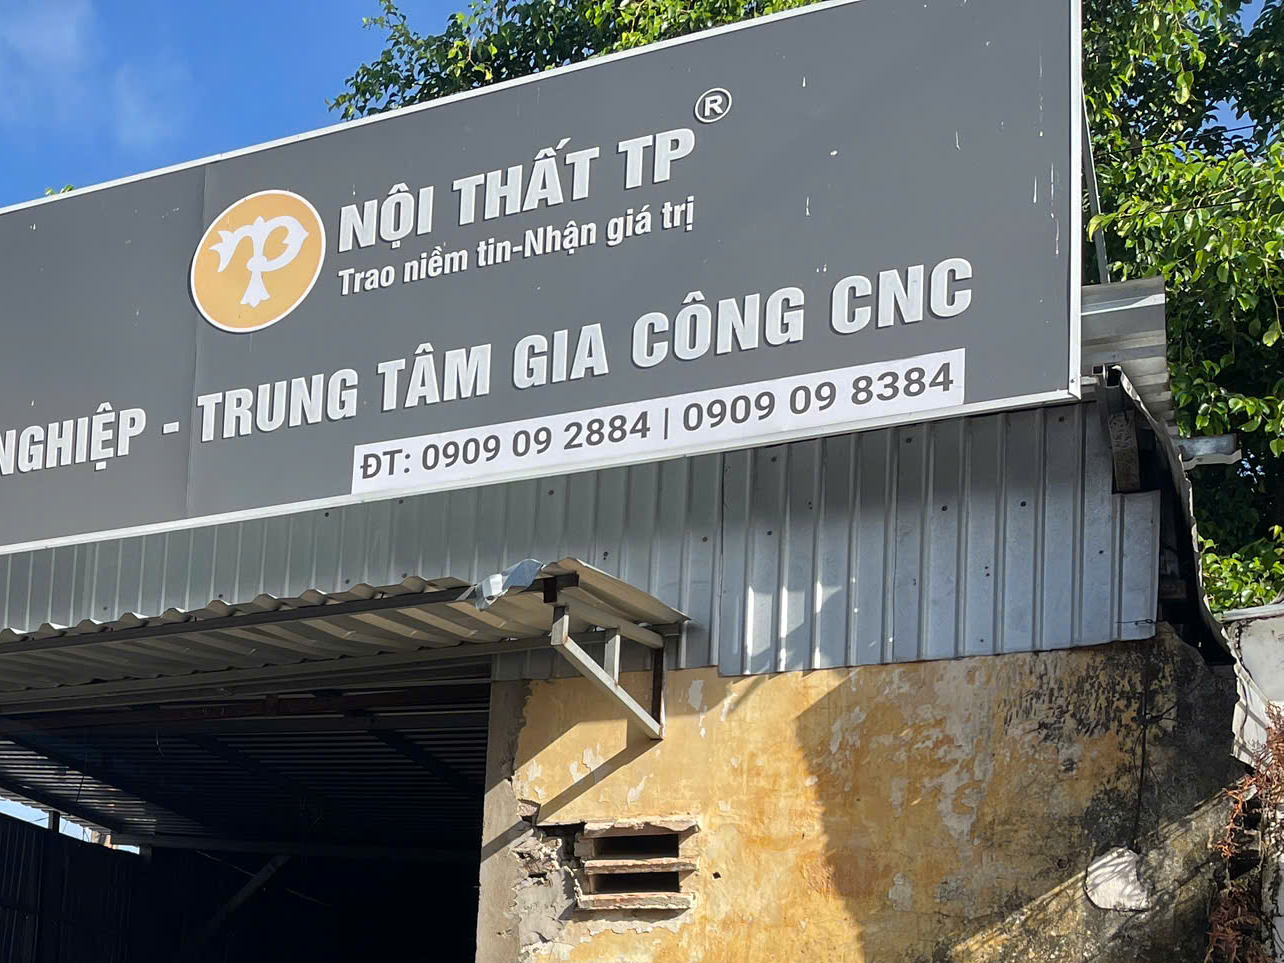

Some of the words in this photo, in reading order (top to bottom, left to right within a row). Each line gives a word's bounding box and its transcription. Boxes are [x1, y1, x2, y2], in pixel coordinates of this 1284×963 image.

[337, 182, 435, 253] NỘI
[452, 137, 601, 227] THẤT
[616, 127, 696, 190] TP
[337, 264, 395, 296] Trao
[403, 244, 468, 284] niềm
[477, 220, 597, 268] tin-Nhận
[606, 204, 652, 248] giá
[661, 195, 695, 232] trị
[196, 367, 359, 443] TRUNG
[376, 342, 492, 412] TÂM
[512, 322, 610, 390] GIA
[631, 291, 806, 369] CÔNG
[830, 257, 973, 336] CNC
[360, 448, 411, 479] ĐT:
[421, 434, 501, 471] 0909
[512, 426, 552, 457] 09
[563, 410, 651, 450] 2884
[682, 391, 776, 432] 0909
[789, 381, 837, 415] 09
[850, 362, 954, 406] 8384
